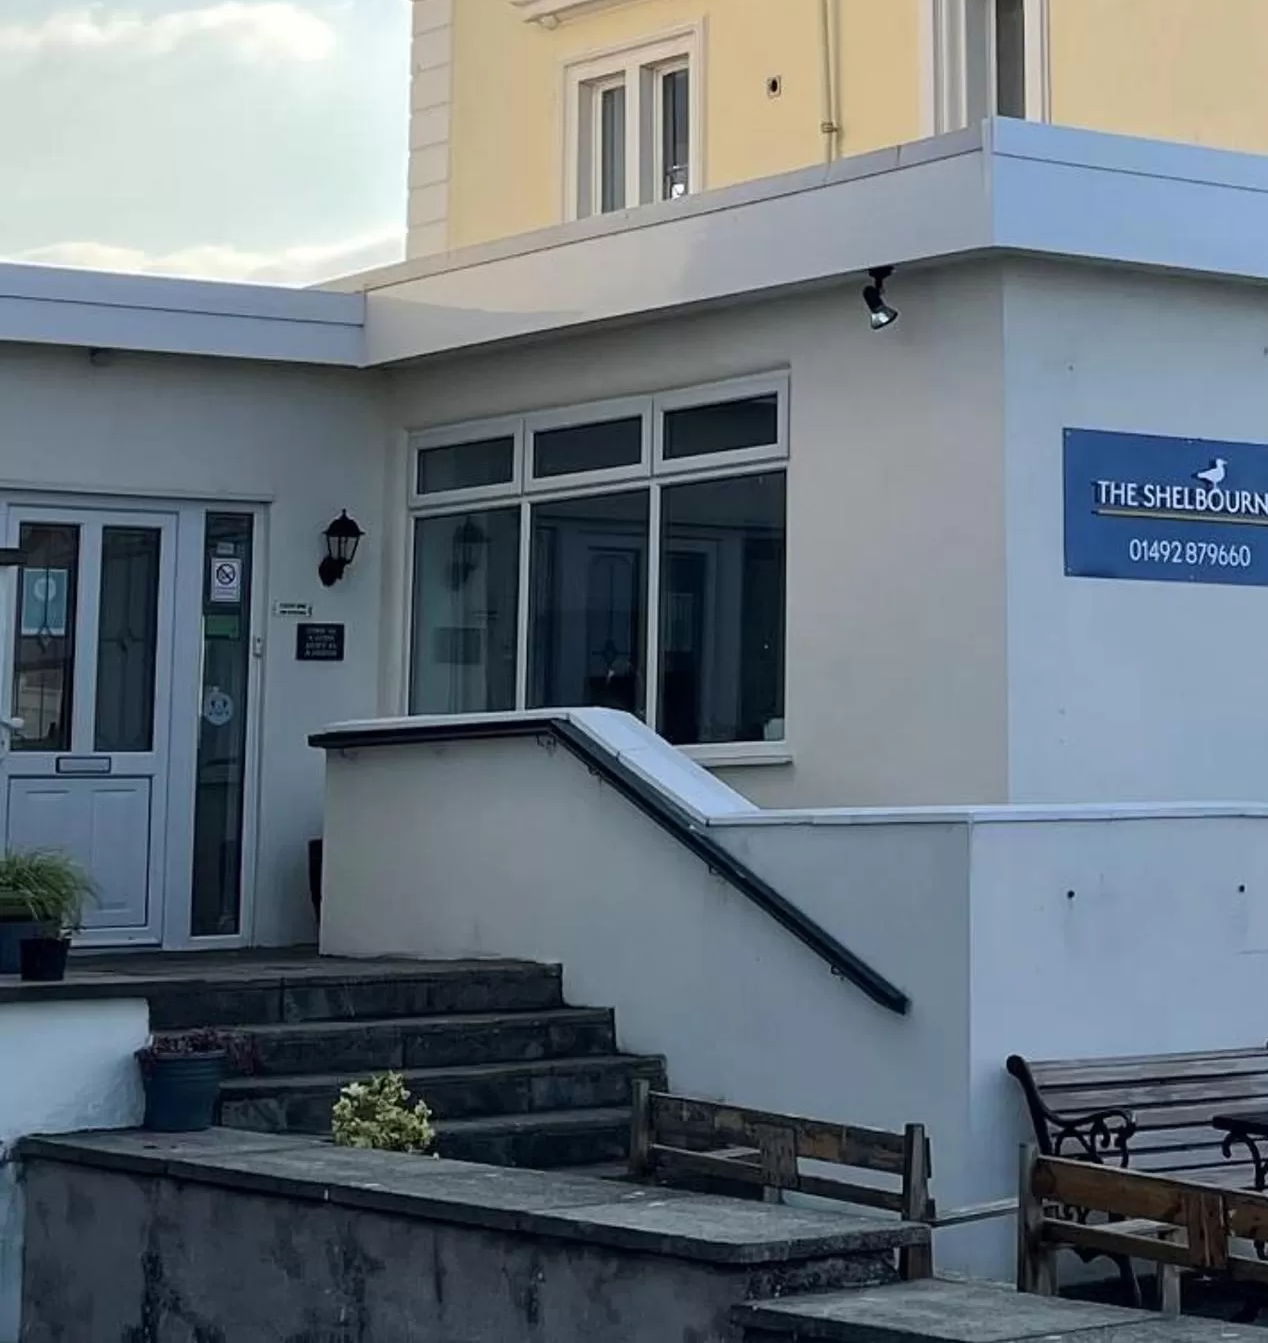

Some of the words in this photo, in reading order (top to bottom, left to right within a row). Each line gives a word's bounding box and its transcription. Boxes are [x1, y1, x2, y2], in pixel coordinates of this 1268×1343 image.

[1098, 480, 1138, 507] THE
[1129, 538, 1182, 563] 01492
[1186, 542, 1251, 567] 879660
